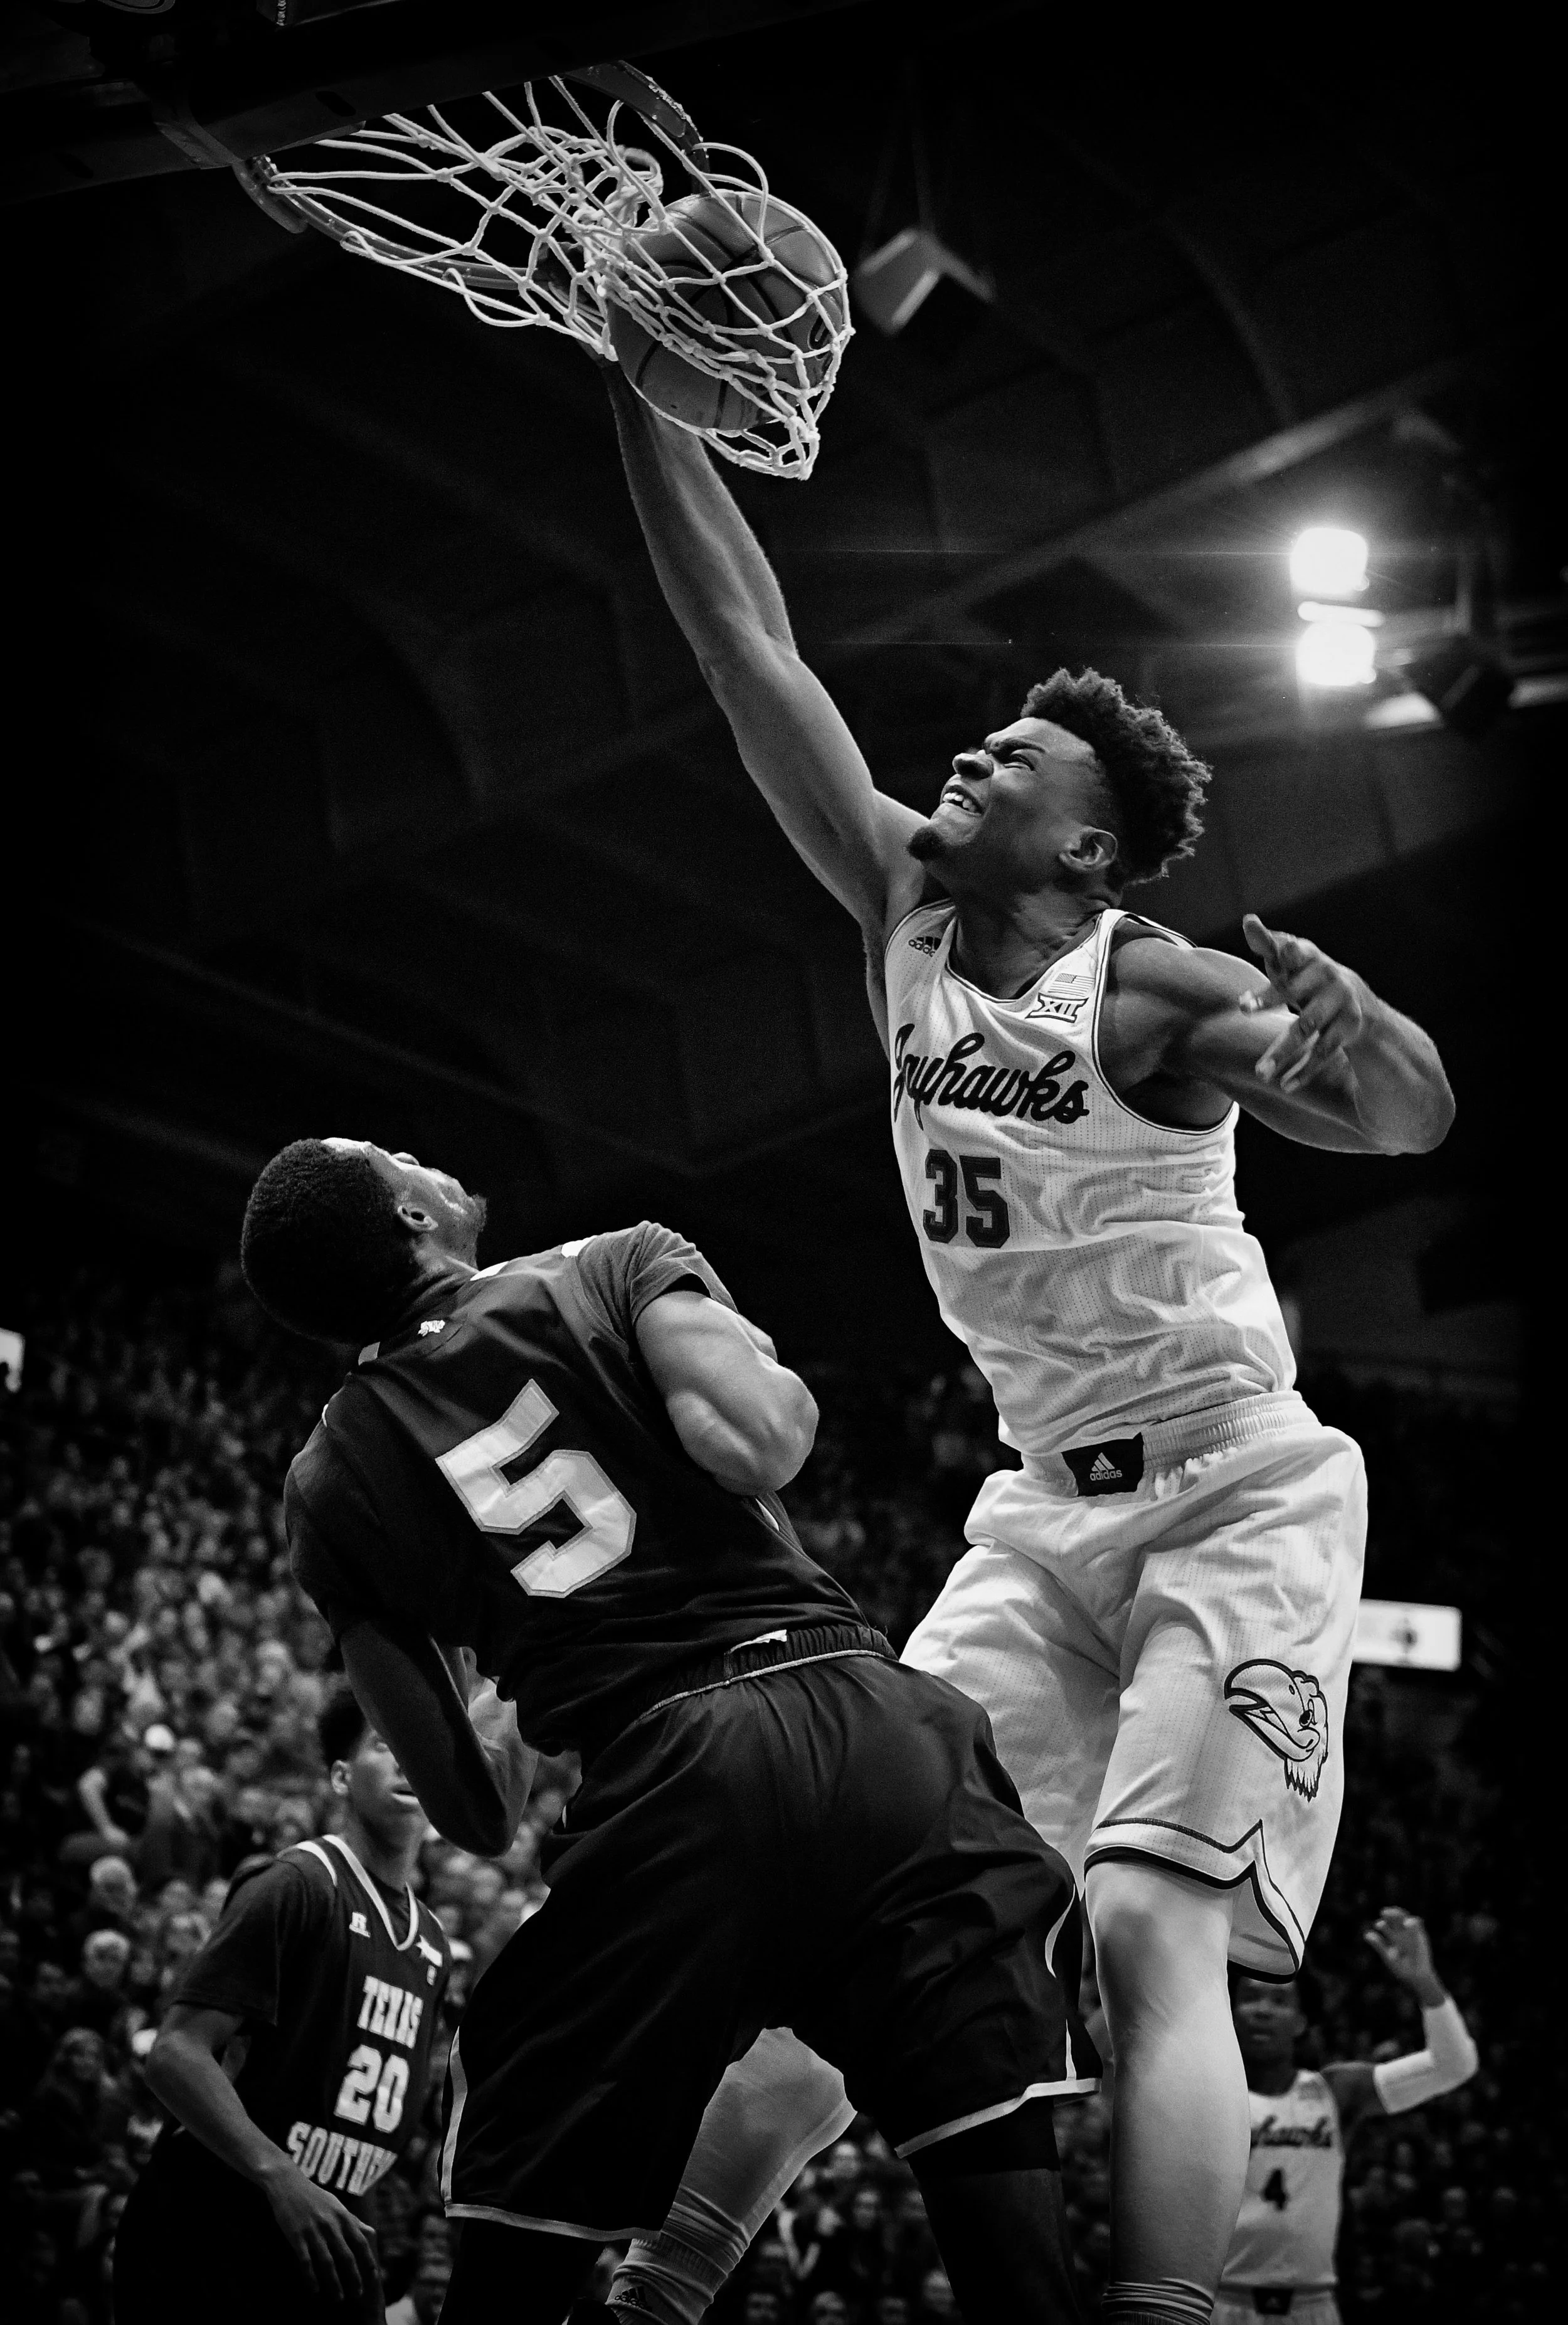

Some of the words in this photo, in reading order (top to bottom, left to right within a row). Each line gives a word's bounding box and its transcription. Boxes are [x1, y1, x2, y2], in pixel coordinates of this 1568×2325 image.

[893, 1023, 1090, 1131] Jayhawks
[923, 1149, 1010, 1248] 35
[435, 1379, 637, 1598] 5
[1089, 1469, 1123, 1481] adidas
[334, 2043, 410, 2133] 20
[1259, 2166, 1289, 2211] 4
